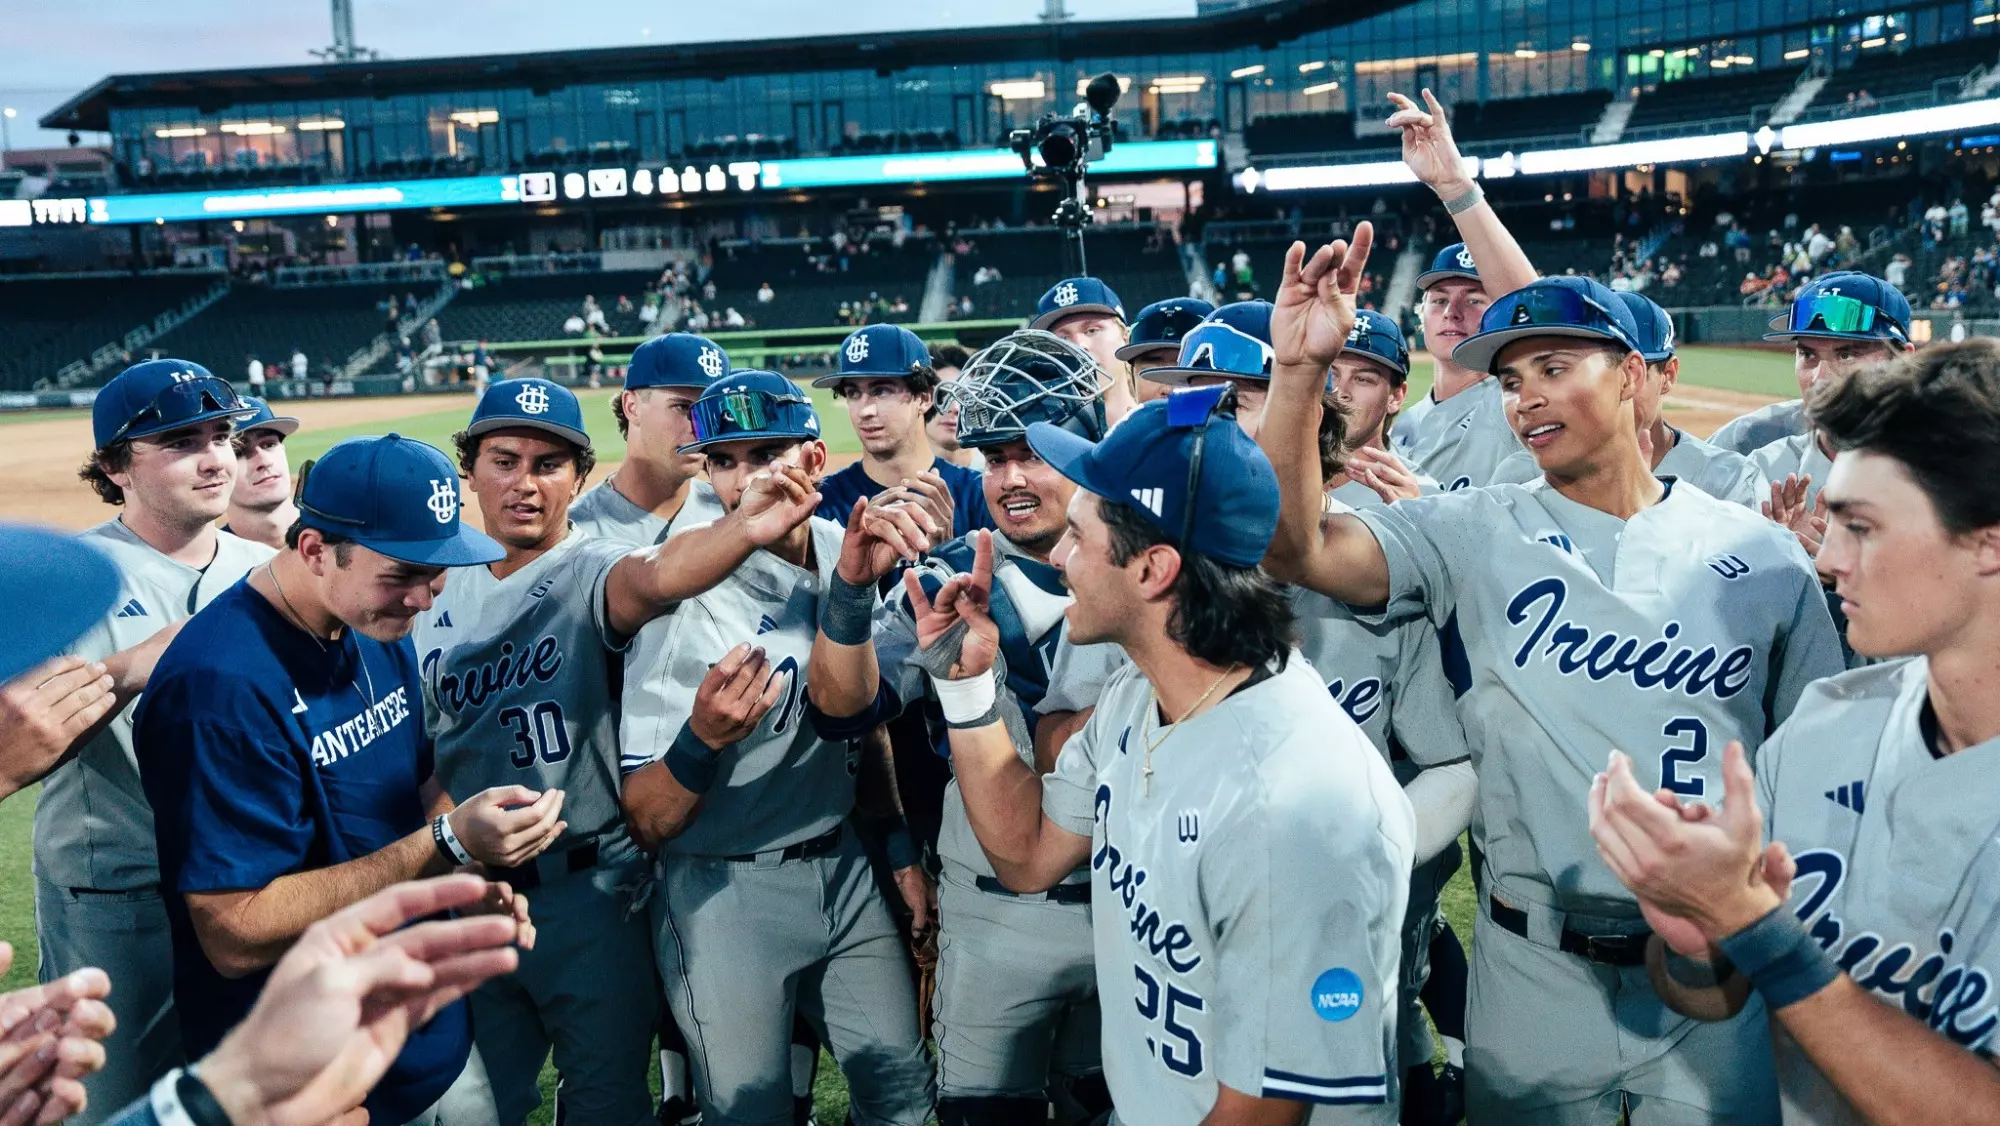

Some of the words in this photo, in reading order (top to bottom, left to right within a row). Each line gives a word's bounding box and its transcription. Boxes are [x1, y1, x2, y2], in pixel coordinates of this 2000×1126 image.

[1505, 576, 1754, 699] Irvine
[311, 686, 410, 767] ANTEATERS
[498, 700, 572, 770] 30
[1659, 716, 1708, 797] 2
[1317, 992, 1359, 1008] NCAA
